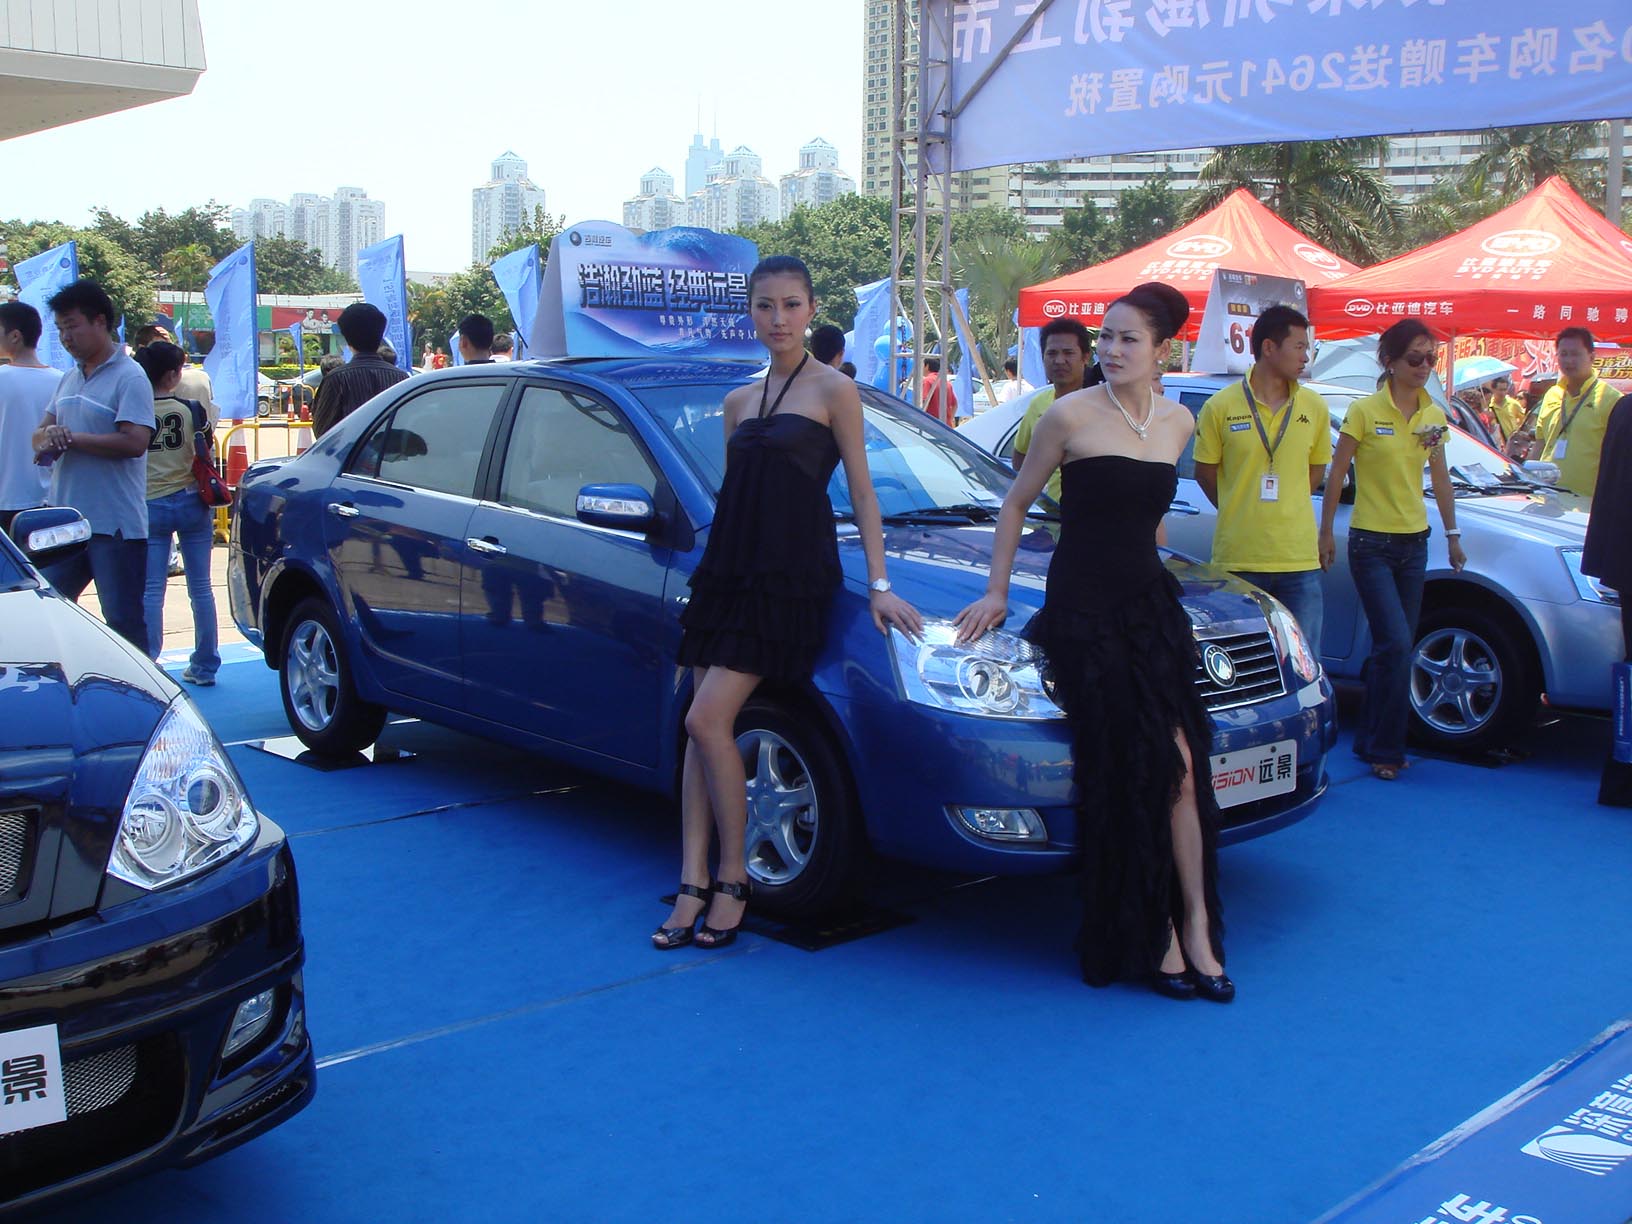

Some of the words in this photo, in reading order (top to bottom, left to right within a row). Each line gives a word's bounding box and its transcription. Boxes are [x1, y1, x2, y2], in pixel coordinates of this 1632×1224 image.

[1046, 305, 1065, 313] BYD
[1069, 302, 1111, 315] 比亚迪
[1376, 302, 1453, 316] 比亚迪汽车
[1507, 304, 1629, 323] 一路同驰骋
[148, 412, 184, 452] 23
[1259, 753, 1292, 785] 远景
[1, 1054, 48, 1105] 景
